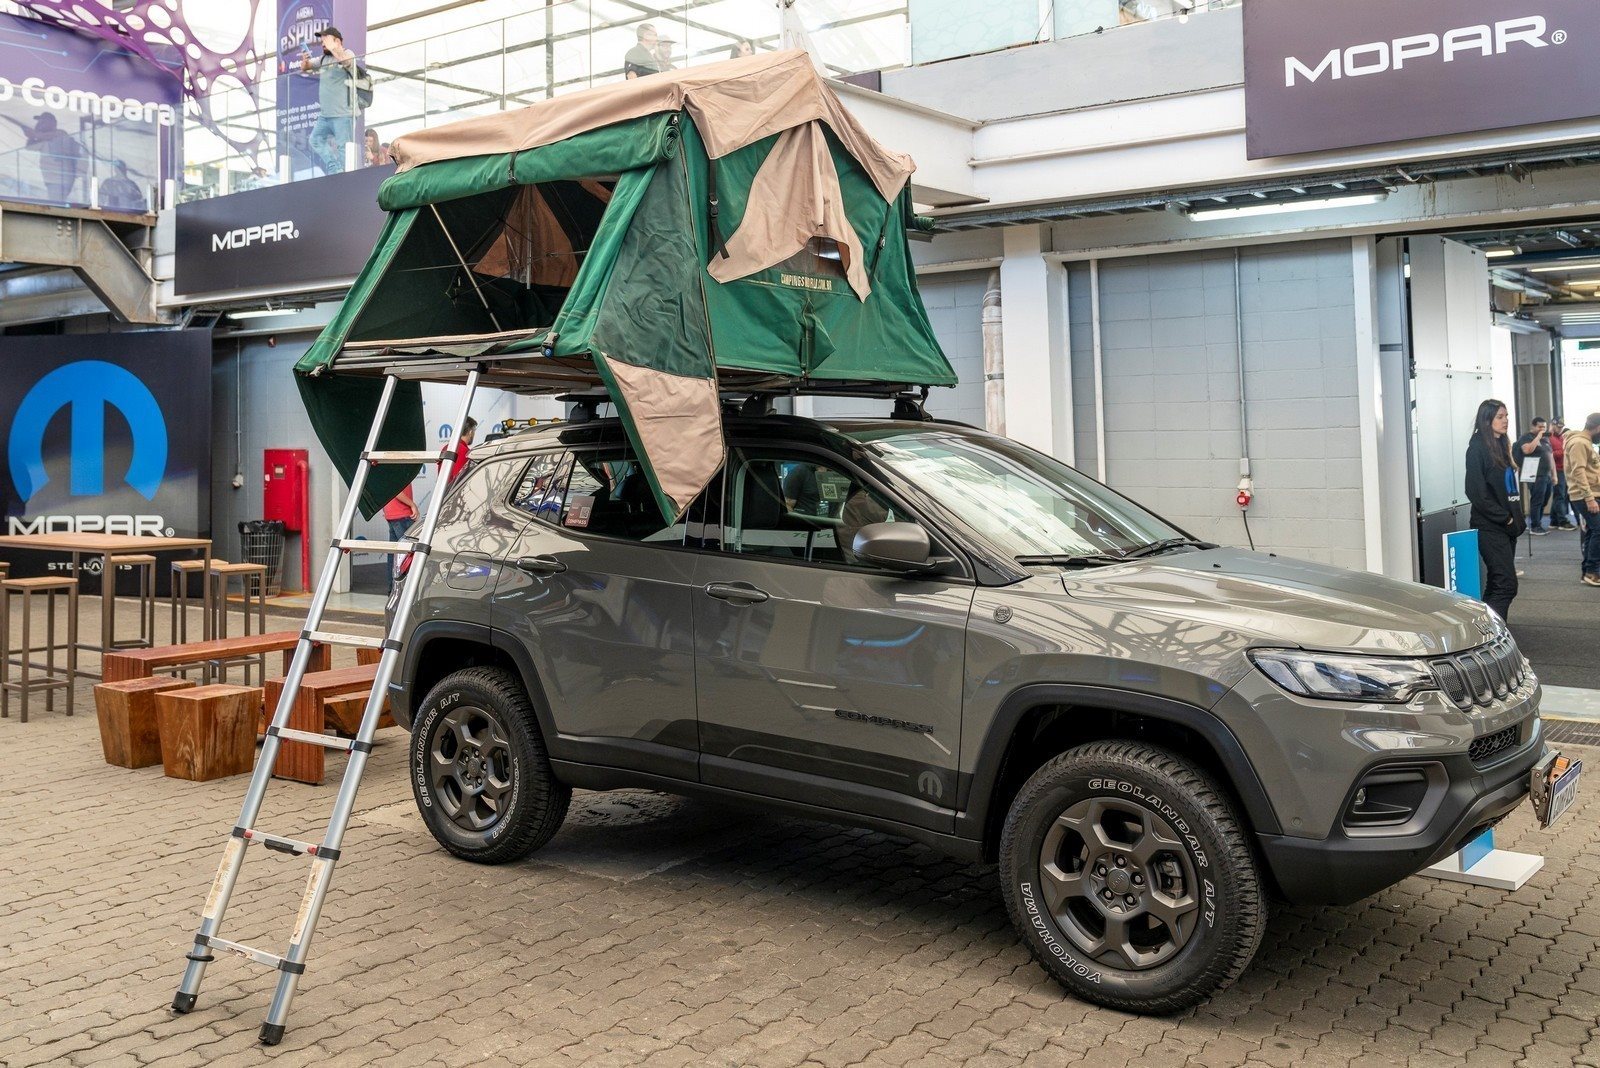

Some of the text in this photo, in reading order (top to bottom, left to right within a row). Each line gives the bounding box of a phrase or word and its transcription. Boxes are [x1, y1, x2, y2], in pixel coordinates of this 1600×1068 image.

[21, 77, 175, 126] Compara
[307, 101, 320, 110] melh
[1449, 546, 1457, 591] PASS
[834, 708, 934, 734] COMPASS
[416, 707, 438, 807] GEOLANDAR
[1088, 778, 1216, 928] GEOLANDAR A/T
[1020, 882, 1103, 984] YOKOHAMA
